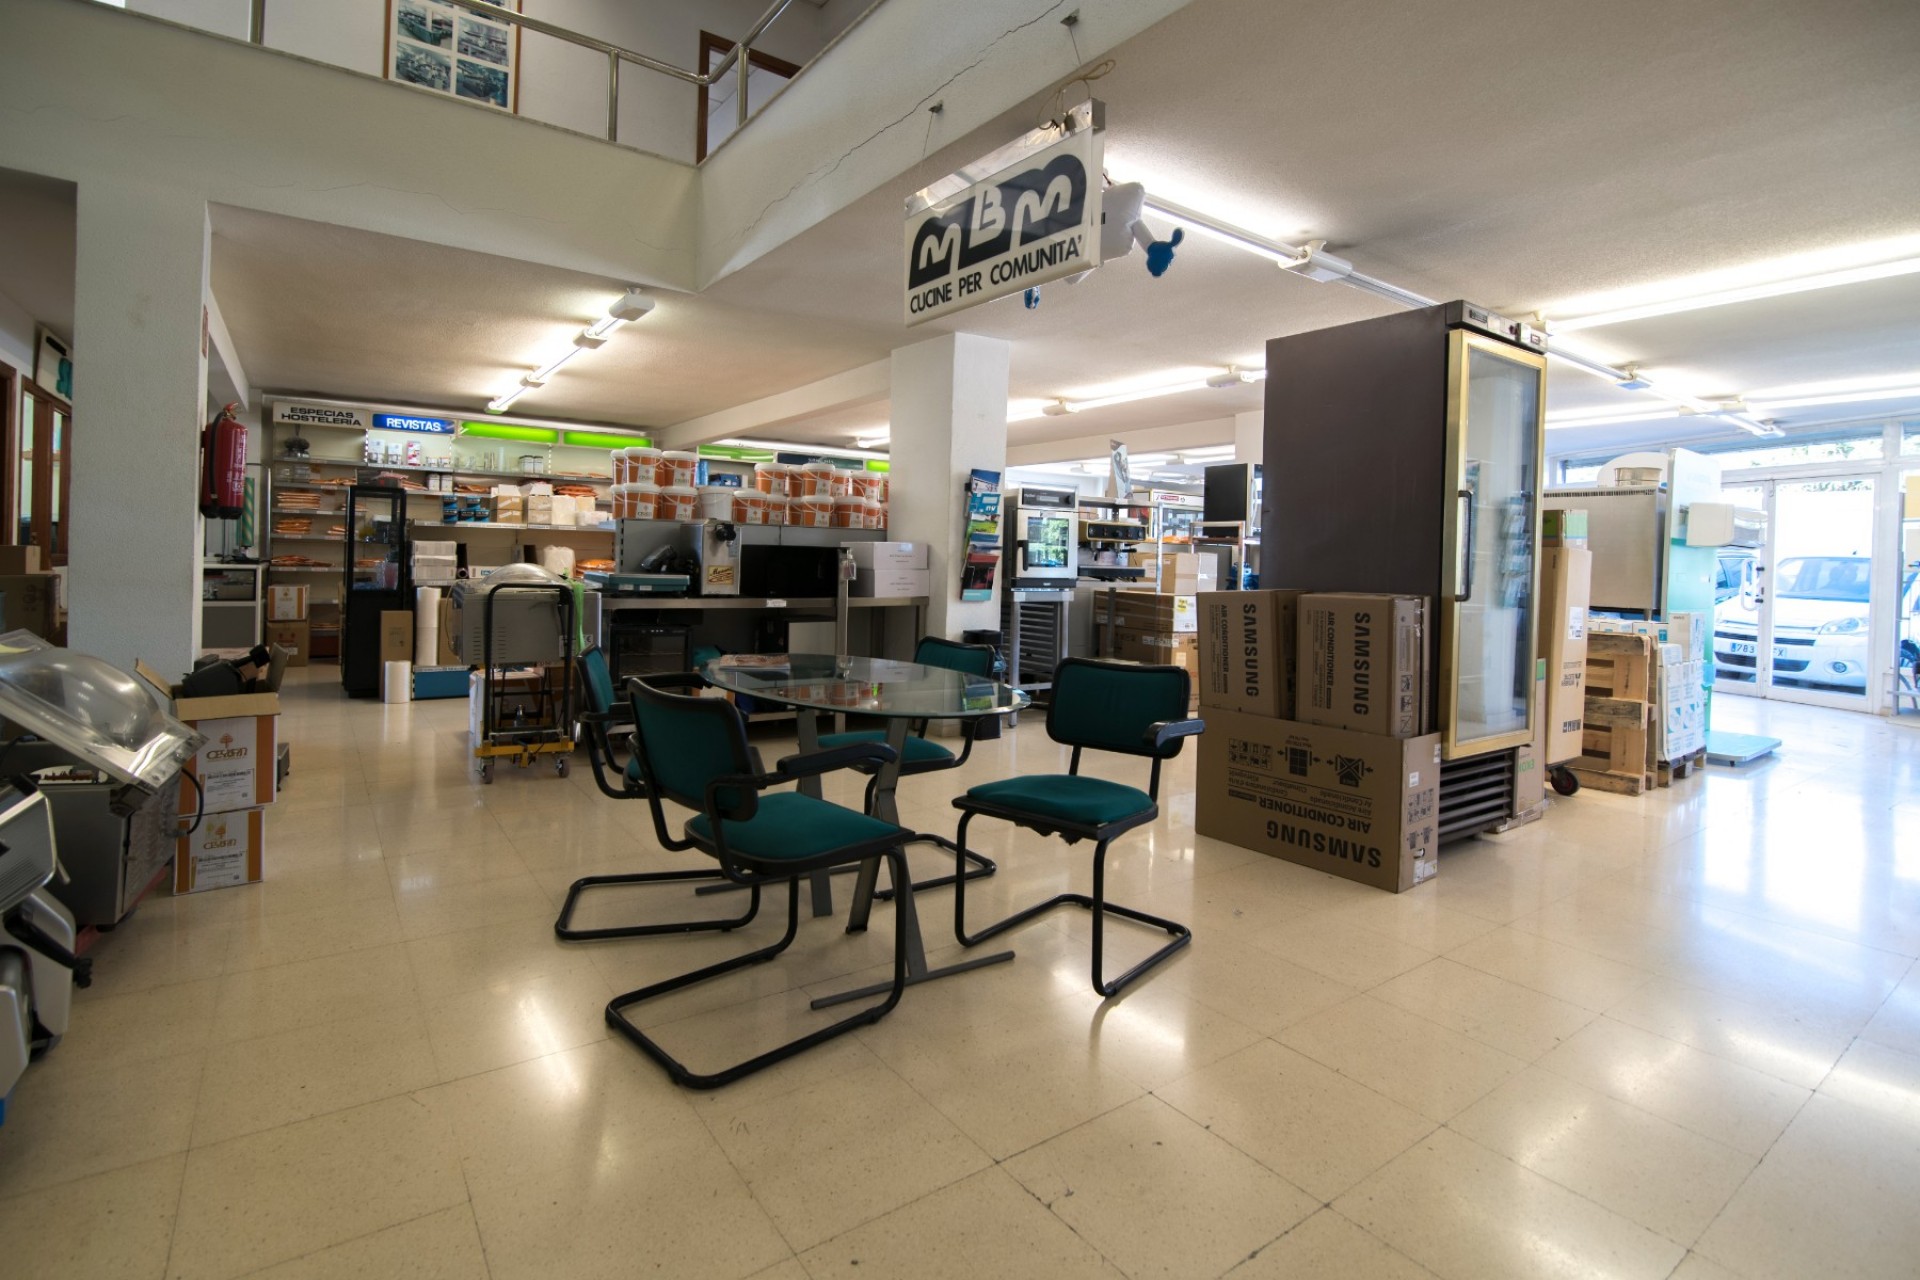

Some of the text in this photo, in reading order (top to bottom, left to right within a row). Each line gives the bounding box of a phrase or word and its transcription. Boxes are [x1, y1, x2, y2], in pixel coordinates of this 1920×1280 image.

[908, 154, 1087, 290] MBM
[910, 283, 952, 314] CUCINE
[959, 271, 983, 297] PER
[290, 406, 354, 419] ESPECIAS
[386, 417, 441, 432] REVISTAS
[1220, 604, 1228, 618] AIR
[1326, 610, 1335, 626] AIR
[1221, 618, 1229, 673] CONDITIONER
[1242, 603, 1260, 697] SAMSUNG
[1326, 626, 1335, 686] CONDITIONER
[1353, 612, 1372, 716] SAMSUNG
[1258, 796, 1345, 828] CONDITIONER
[1347, 817, 1372, 834] AIR
[1266, 819, 1382, 869] SAMSUNG
